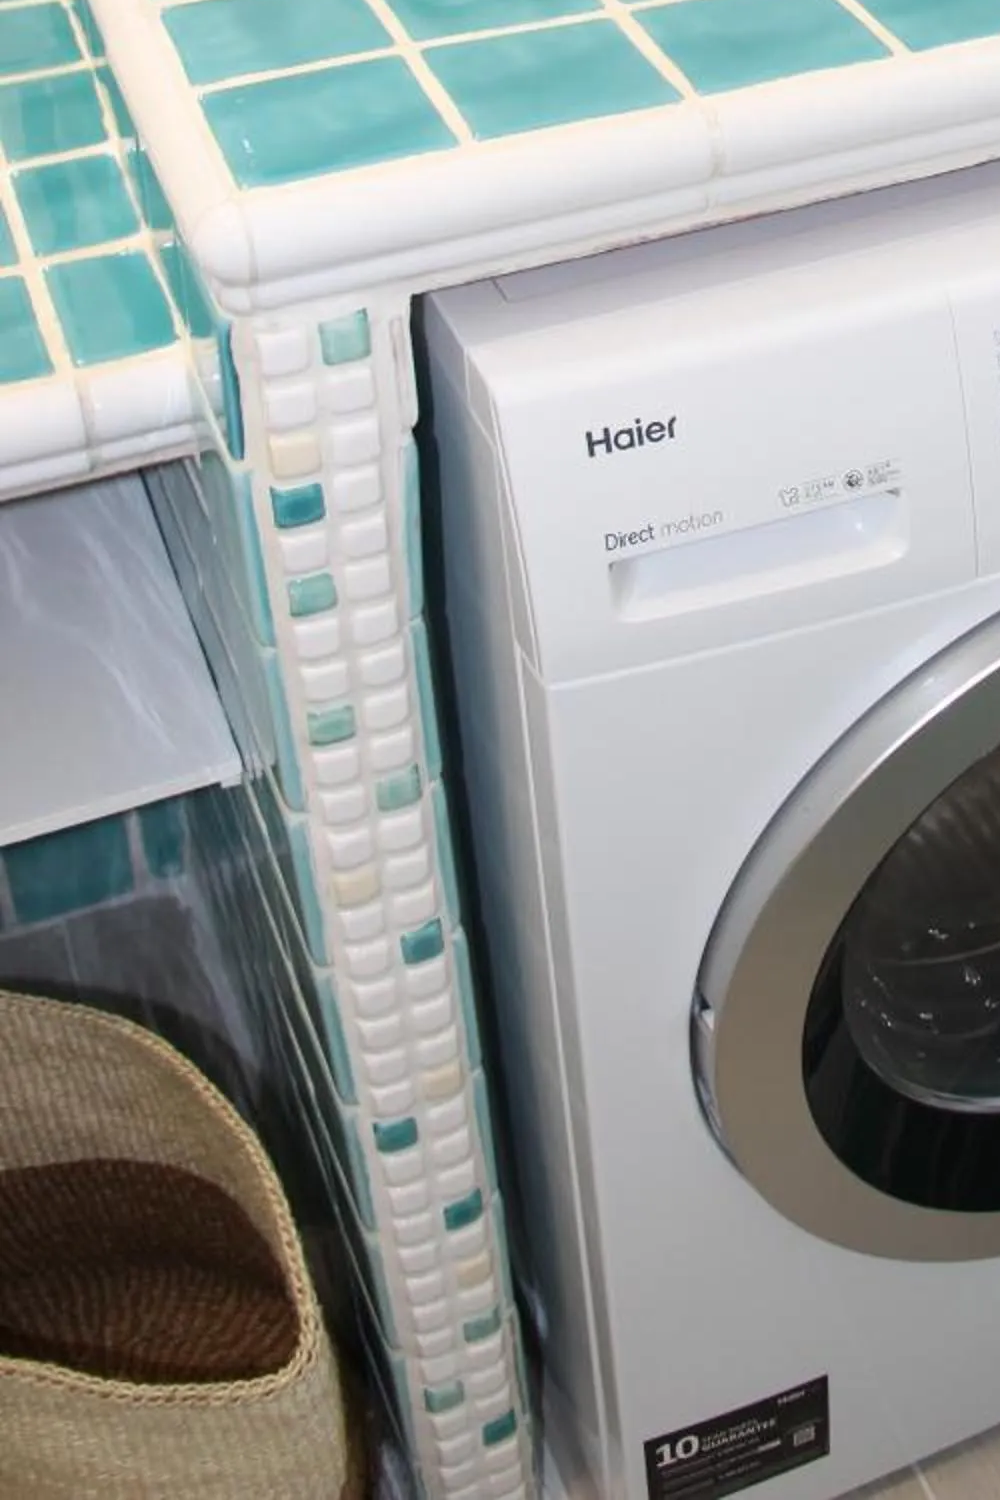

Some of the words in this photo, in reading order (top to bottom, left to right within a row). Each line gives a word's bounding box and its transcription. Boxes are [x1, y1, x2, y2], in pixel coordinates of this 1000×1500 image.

[585, 415, 677, 457] Haier
[604, 523, 655, 552] Direct
[659, 508, 725, 539] motion
[655, 1434, 700, 1468] 10
